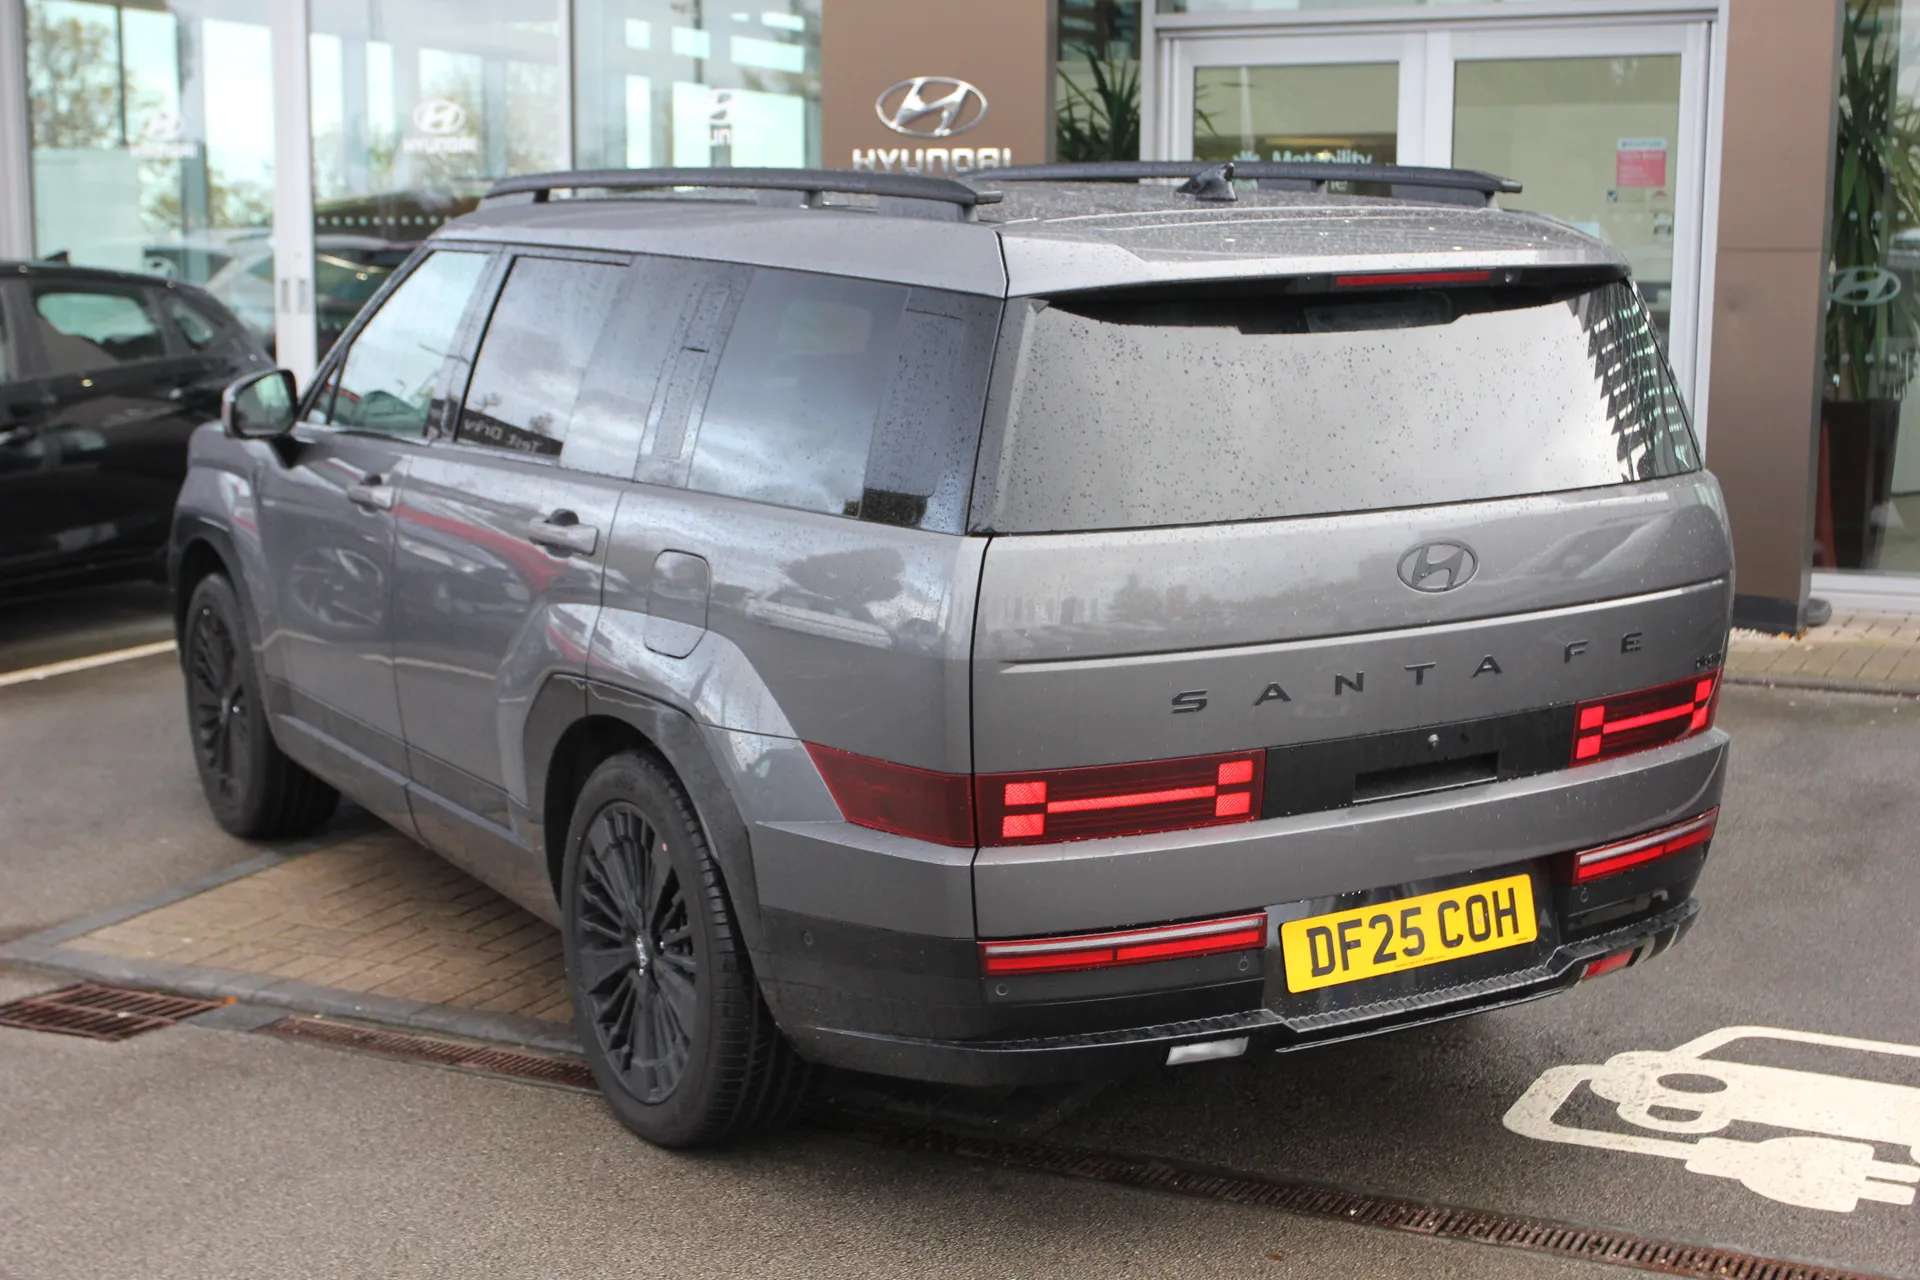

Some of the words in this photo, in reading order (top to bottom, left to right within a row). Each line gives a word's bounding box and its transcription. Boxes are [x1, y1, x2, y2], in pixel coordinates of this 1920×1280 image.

[852, 148, 1012, 175] HYUNDAI
[1171, 654, 1503, 714] SANTA
[1563, 632, 1643, 663] FE
[1306, 906, 1425, 977] DF25
[1438, 887, 1520, 949] COH
